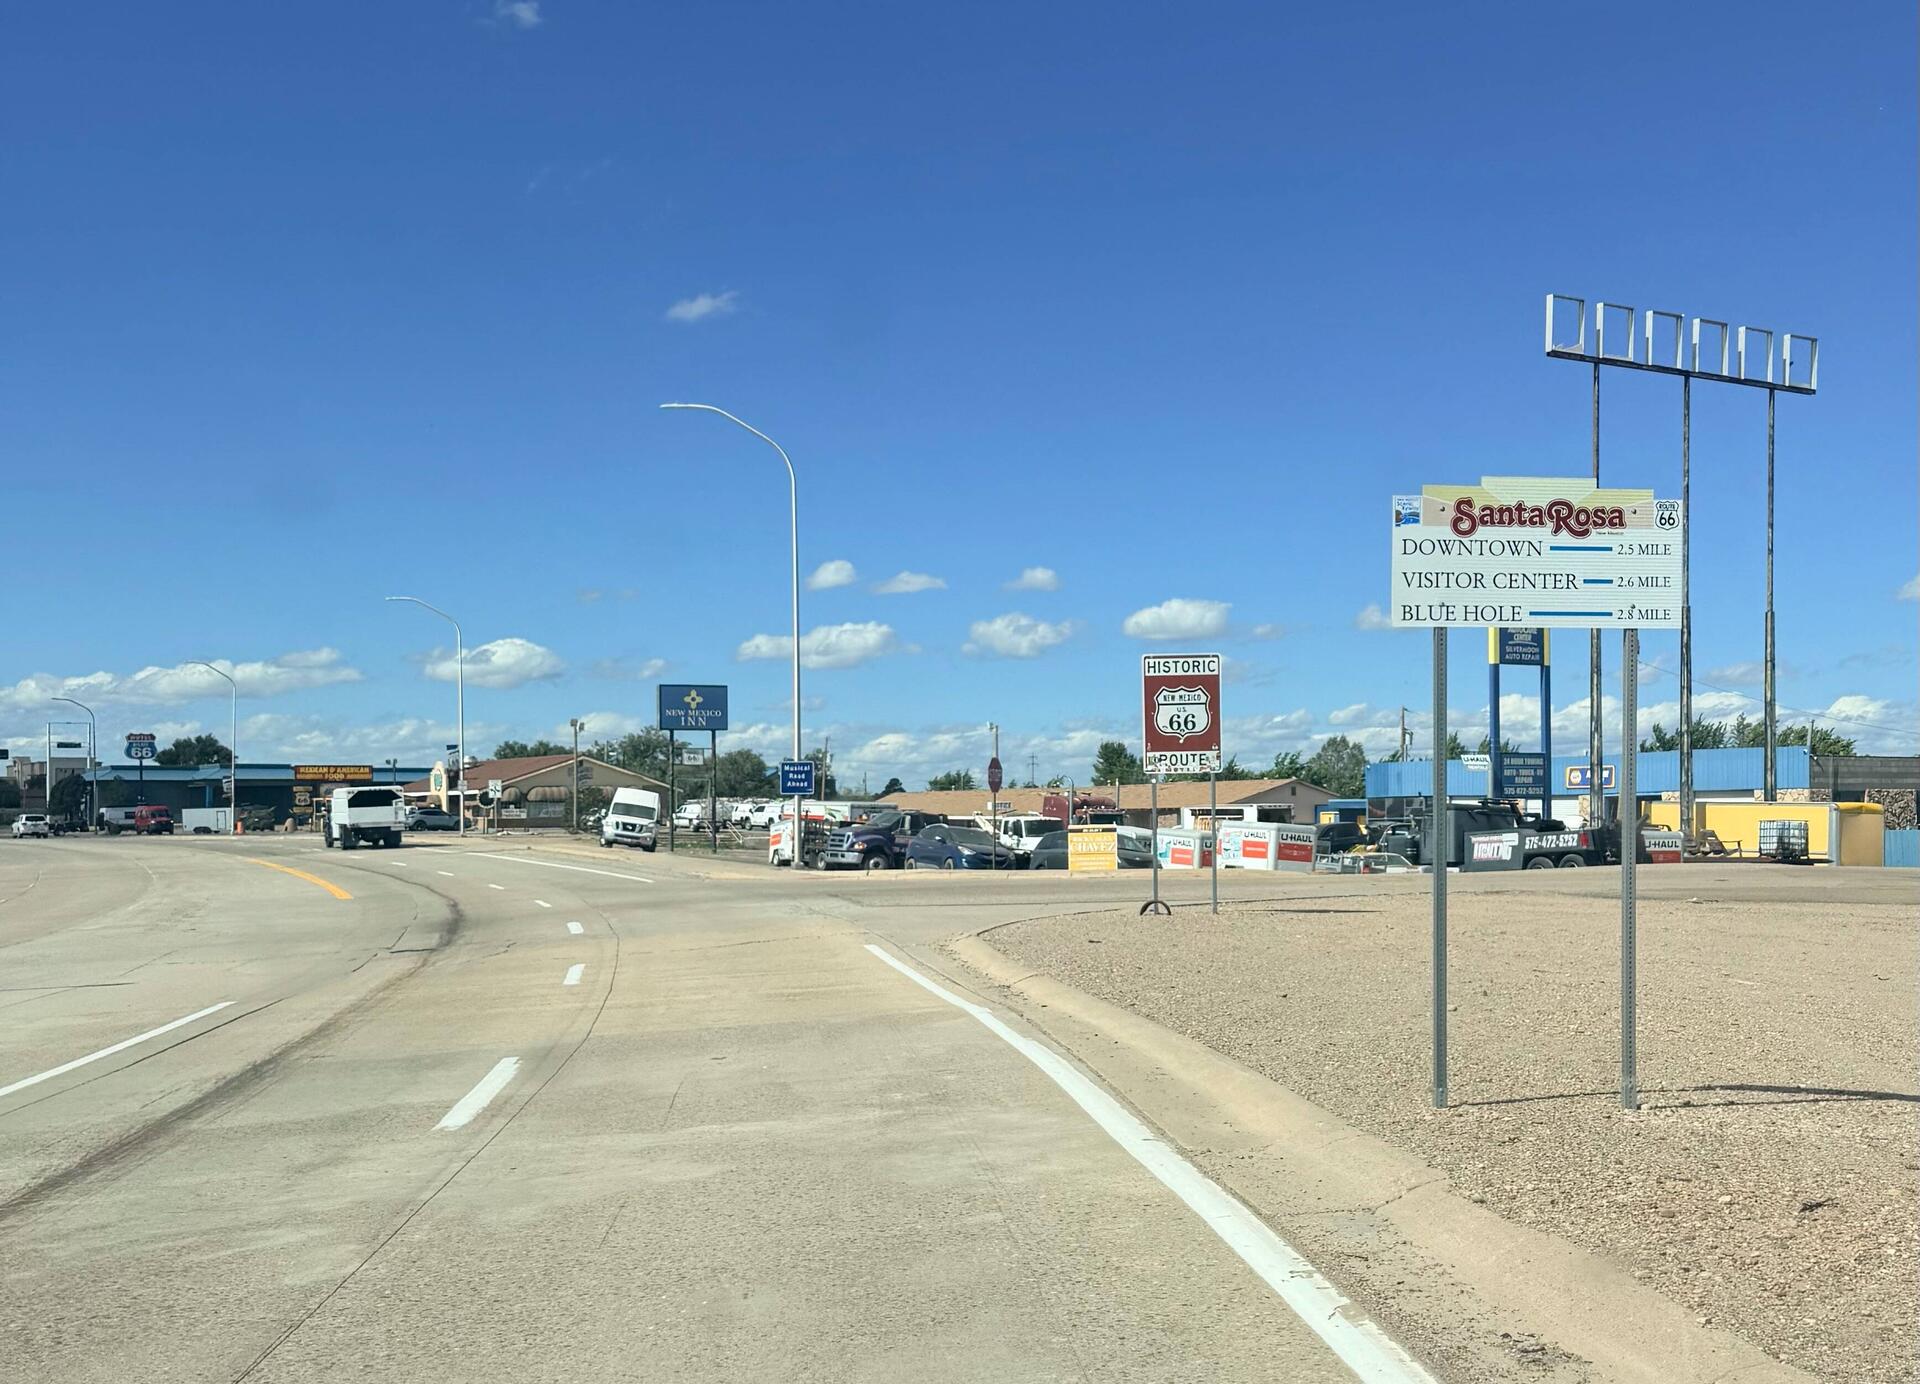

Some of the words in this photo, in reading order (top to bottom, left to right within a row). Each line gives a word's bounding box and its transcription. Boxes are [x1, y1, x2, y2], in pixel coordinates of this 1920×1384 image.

[1451, 497, 1546, 538] Santa
[1545, 498, 1627, 539] Rosa
[1659, 512, 1676, 526] 66
[1401, 538, 1543, 556] DOWNTOWN
[1617, 543, 1634, 556] 2.5
[1638, 543, 1671, 556] MILE
[1402, 571, 1486, 589] VISITOR
[1492, 572, 1579, 590] CENTER
[1617, 576, 1634, 588] 2.6
[1638, 576, 1671, 588] MILE
[1401, 604, 1457, 622] BLUE
[1463, 605, 1522, 622] HOLE
[1617, 609, 1634, 621] 2.8
[1638, 609, 1671, 621] MILE
[1521, 653, 1540, 661] REPAIR
[1147, 660, 1217, 674] HISTORIC
[1163, 694, 1176, 702] NEW
[1178, 694, 1202, 702] MEXICO
[665, 709, 685, 717] NEW
[687, 709, 722, 717] MEXICO
[681, 716, 707, 726] INN
[1168, 713, 1197, 732] 66
[131, 747, 153, 758] 66
[1159, 753, 1207, 767] ROUTE
[784, 764, 811, 772] Musical
[786, 780, 808, 788] Ahead
[1280, 833, 1313, 843] U-HAUL
